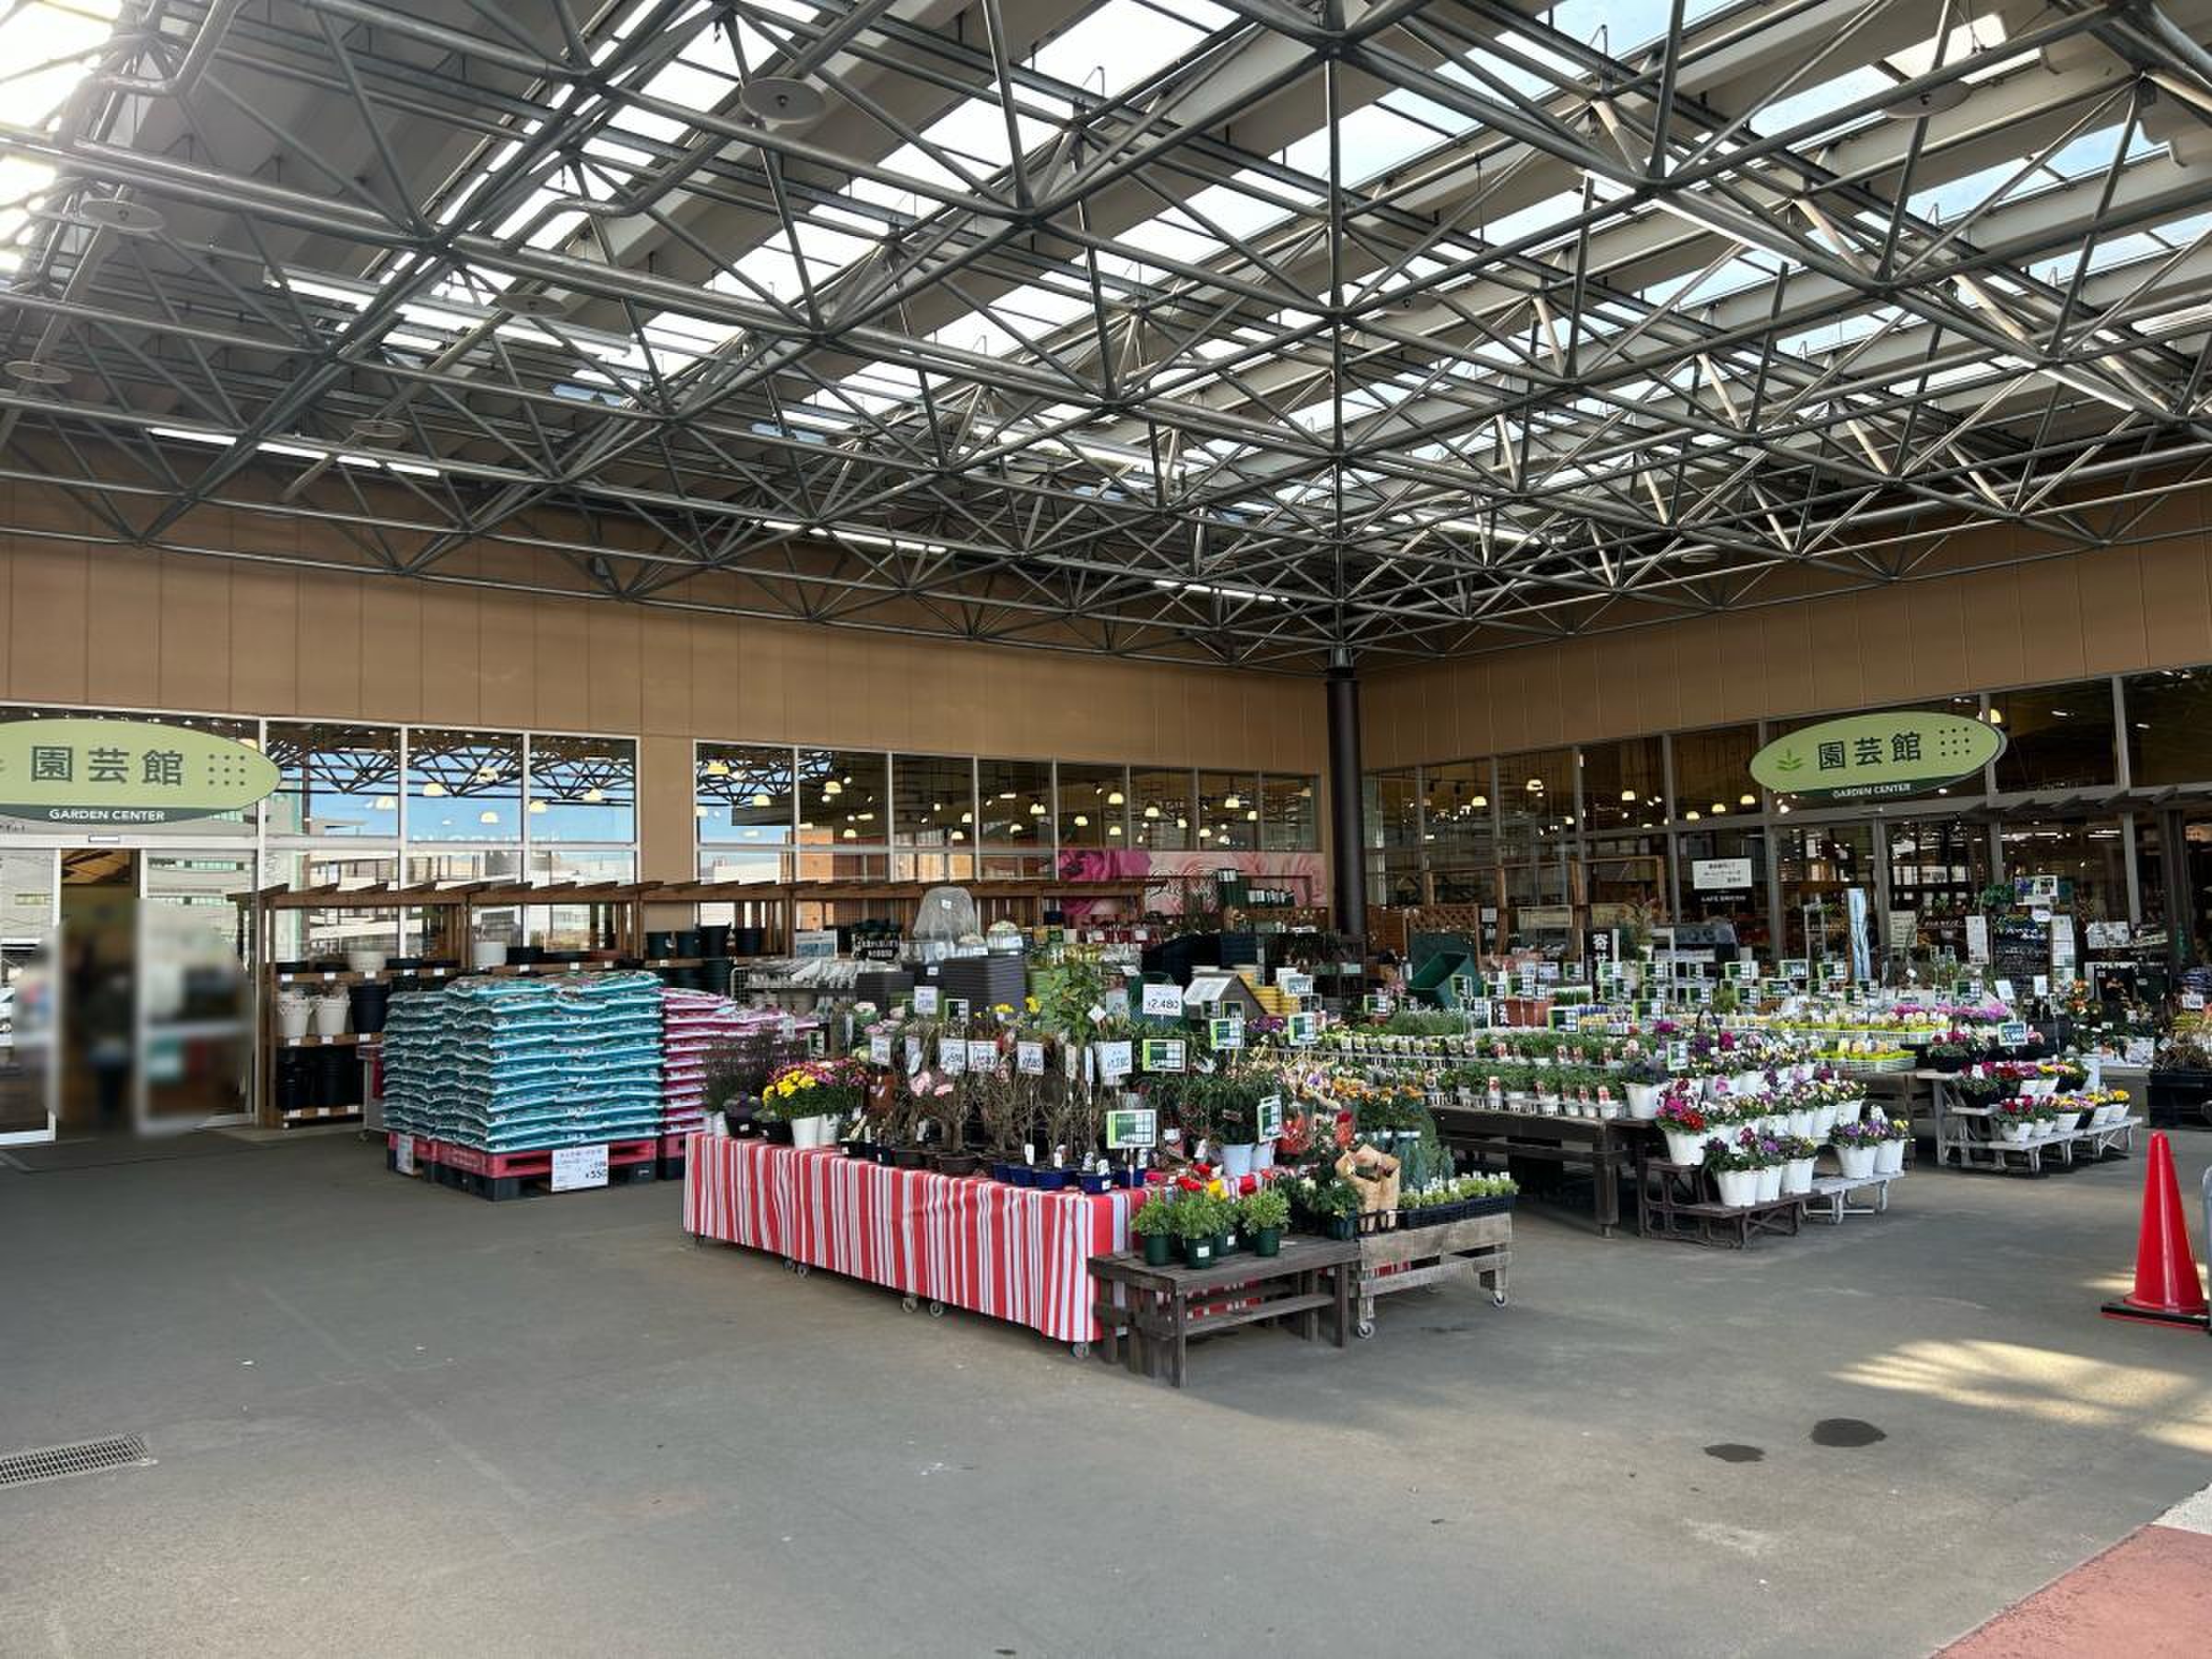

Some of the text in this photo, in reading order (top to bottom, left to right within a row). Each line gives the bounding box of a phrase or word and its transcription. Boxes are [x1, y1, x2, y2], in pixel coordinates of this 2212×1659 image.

[1818, 732, 1922, 771] 園芸館
[30, 746, 183, 785] 園芸館
[1832, 783, 1912, 797] GARDEN CENTER
[49, 808, 165, 822] GARDEN CENTER
